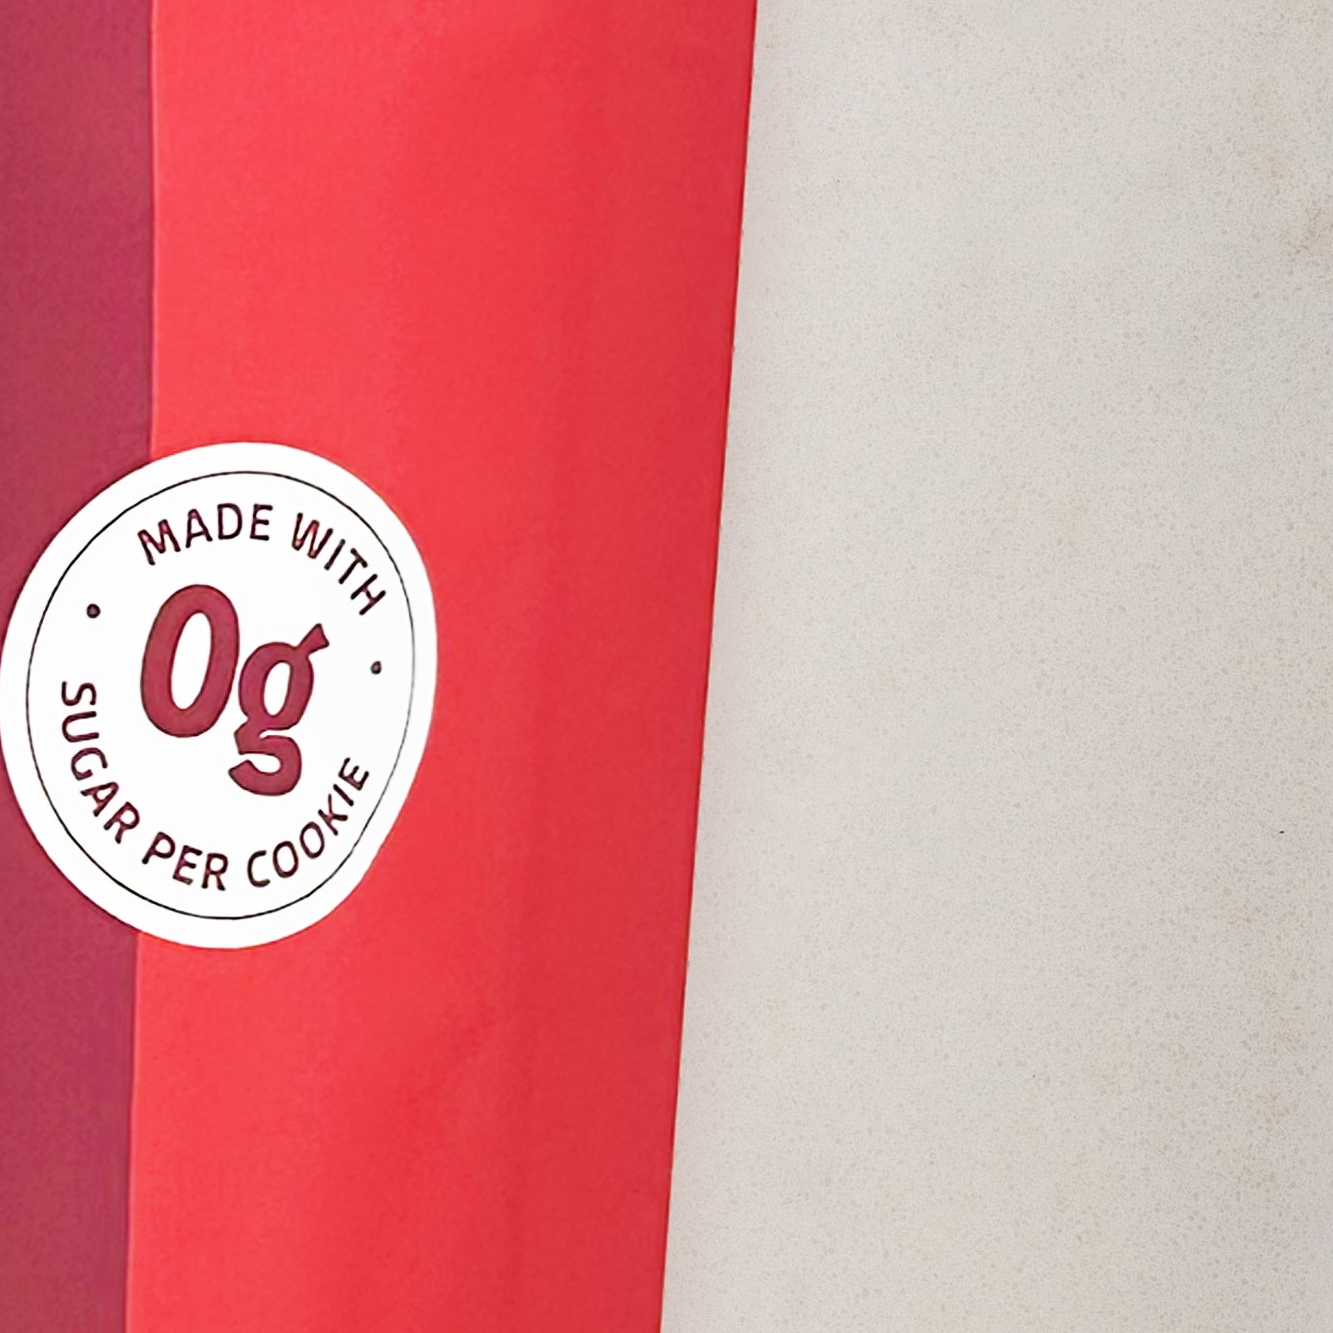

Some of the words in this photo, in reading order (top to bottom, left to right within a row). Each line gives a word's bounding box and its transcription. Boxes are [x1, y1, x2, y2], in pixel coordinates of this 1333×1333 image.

[136, 502, 274, 566] MADE
[291, 512, 387, 616] WITH
[60, 680, 141, 844] SUGAR
[141, 831, 230, 892] PER
[246, 756, 371, 888] COOKIE
[139, 583, 330, 797] 0g
